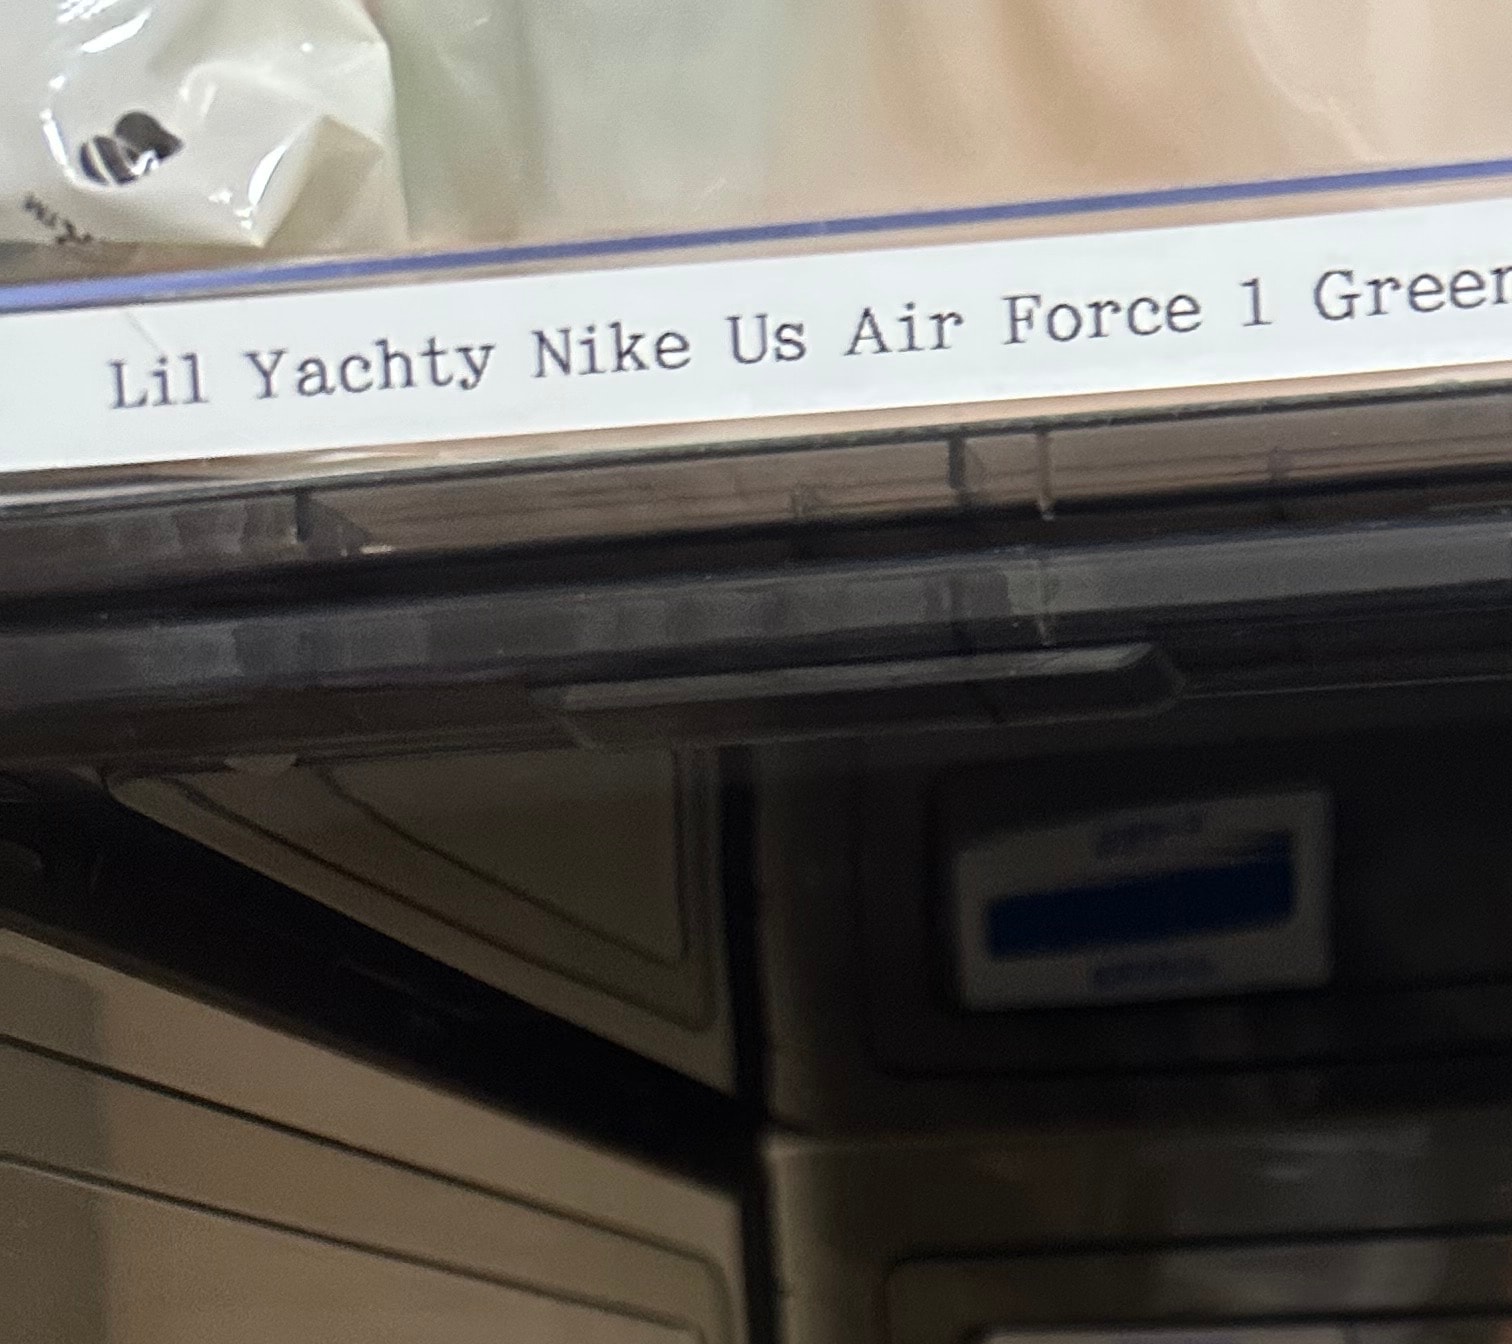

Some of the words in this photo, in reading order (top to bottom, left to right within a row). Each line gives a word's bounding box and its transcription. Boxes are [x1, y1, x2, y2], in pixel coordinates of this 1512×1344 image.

[108, 351, 210, 411] Lil
[246, 337, 496, 395] Yachty
[531, 321, 693, 381] Nike
[726, 312, 806, 367] Us
[845, 302, 967, 358] Air
[1002, 287, 1202, 346] Force
[1240, 277, 1273, 328] 1
